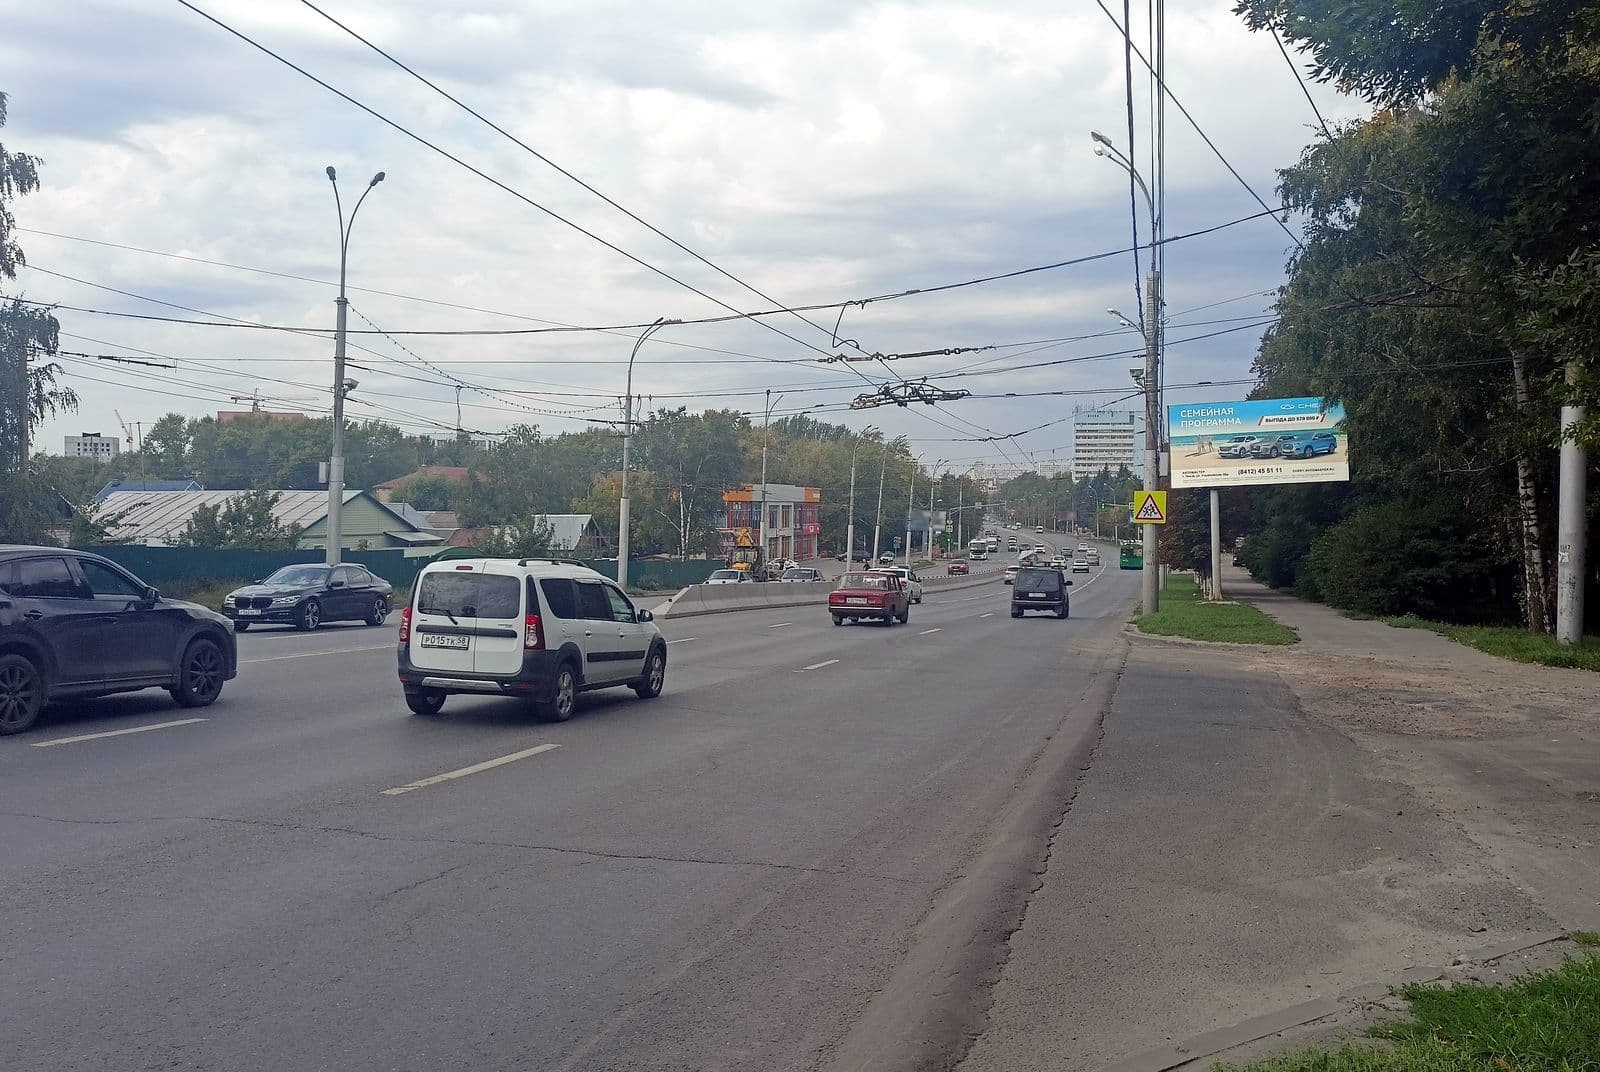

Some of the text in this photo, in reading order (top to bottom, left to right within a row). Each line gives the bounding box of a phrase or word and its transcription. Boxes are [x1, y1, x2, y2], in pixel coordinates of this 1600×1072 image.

[1181, 407, 1234, 418] СЕМЕЙНАЯ
[1181, 417, 1241, 428] ПРОГРАММА
[457, 637, 466, 645] 58
